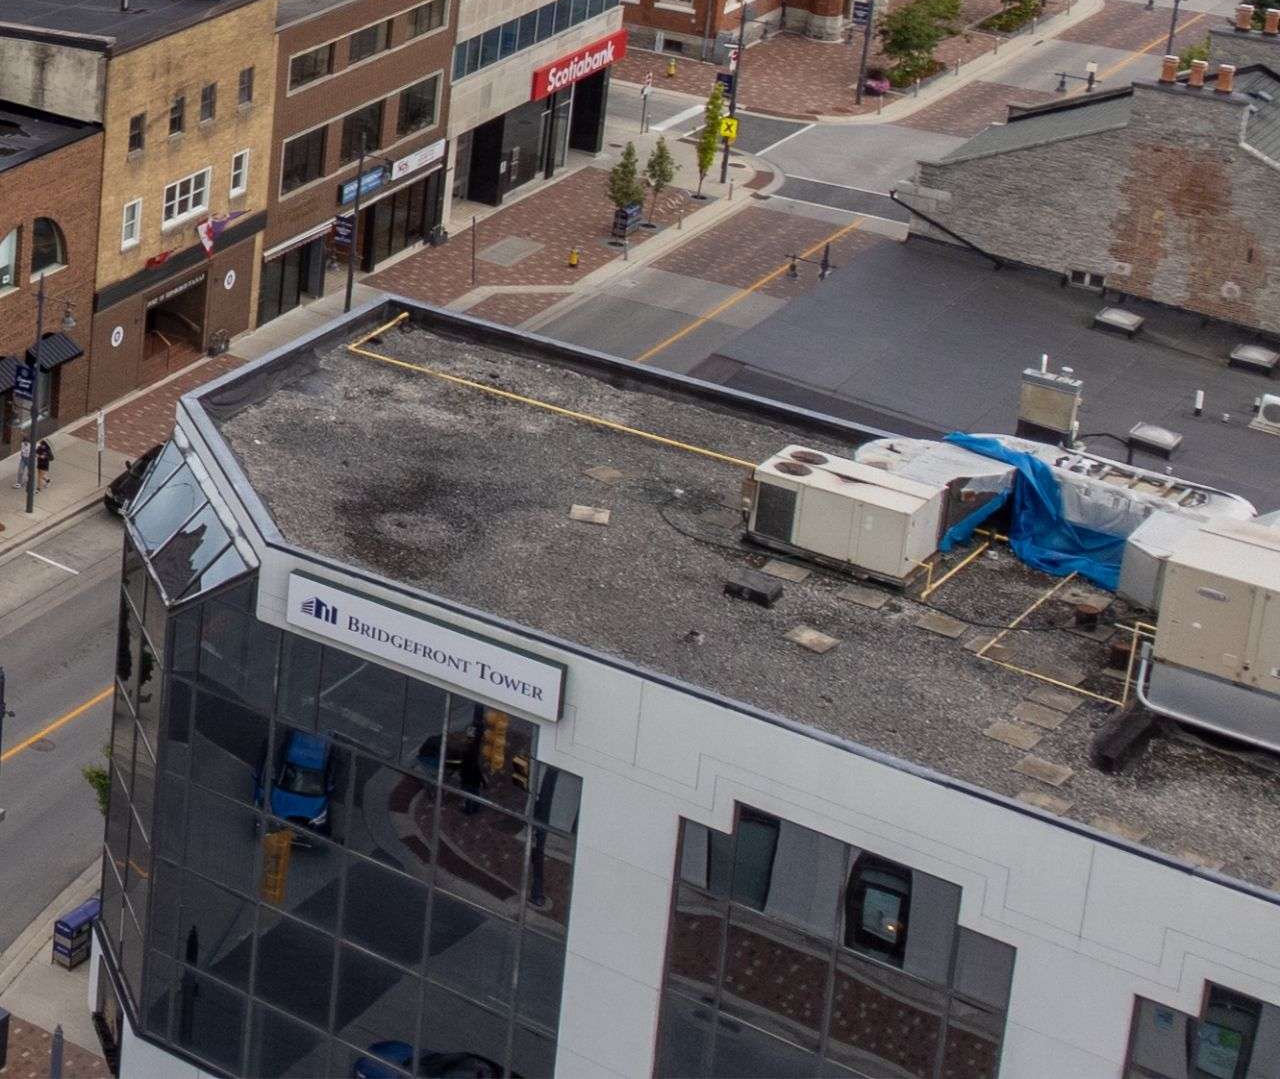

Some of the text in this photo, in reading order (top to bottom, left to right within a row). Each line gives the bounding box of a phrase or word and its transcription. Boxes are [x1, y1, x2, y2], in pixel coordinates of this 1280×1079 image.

[547, 40, 615, 92] Scotiabank
[347, 616, 543, 701] BRIDGEFRONT TOWER
